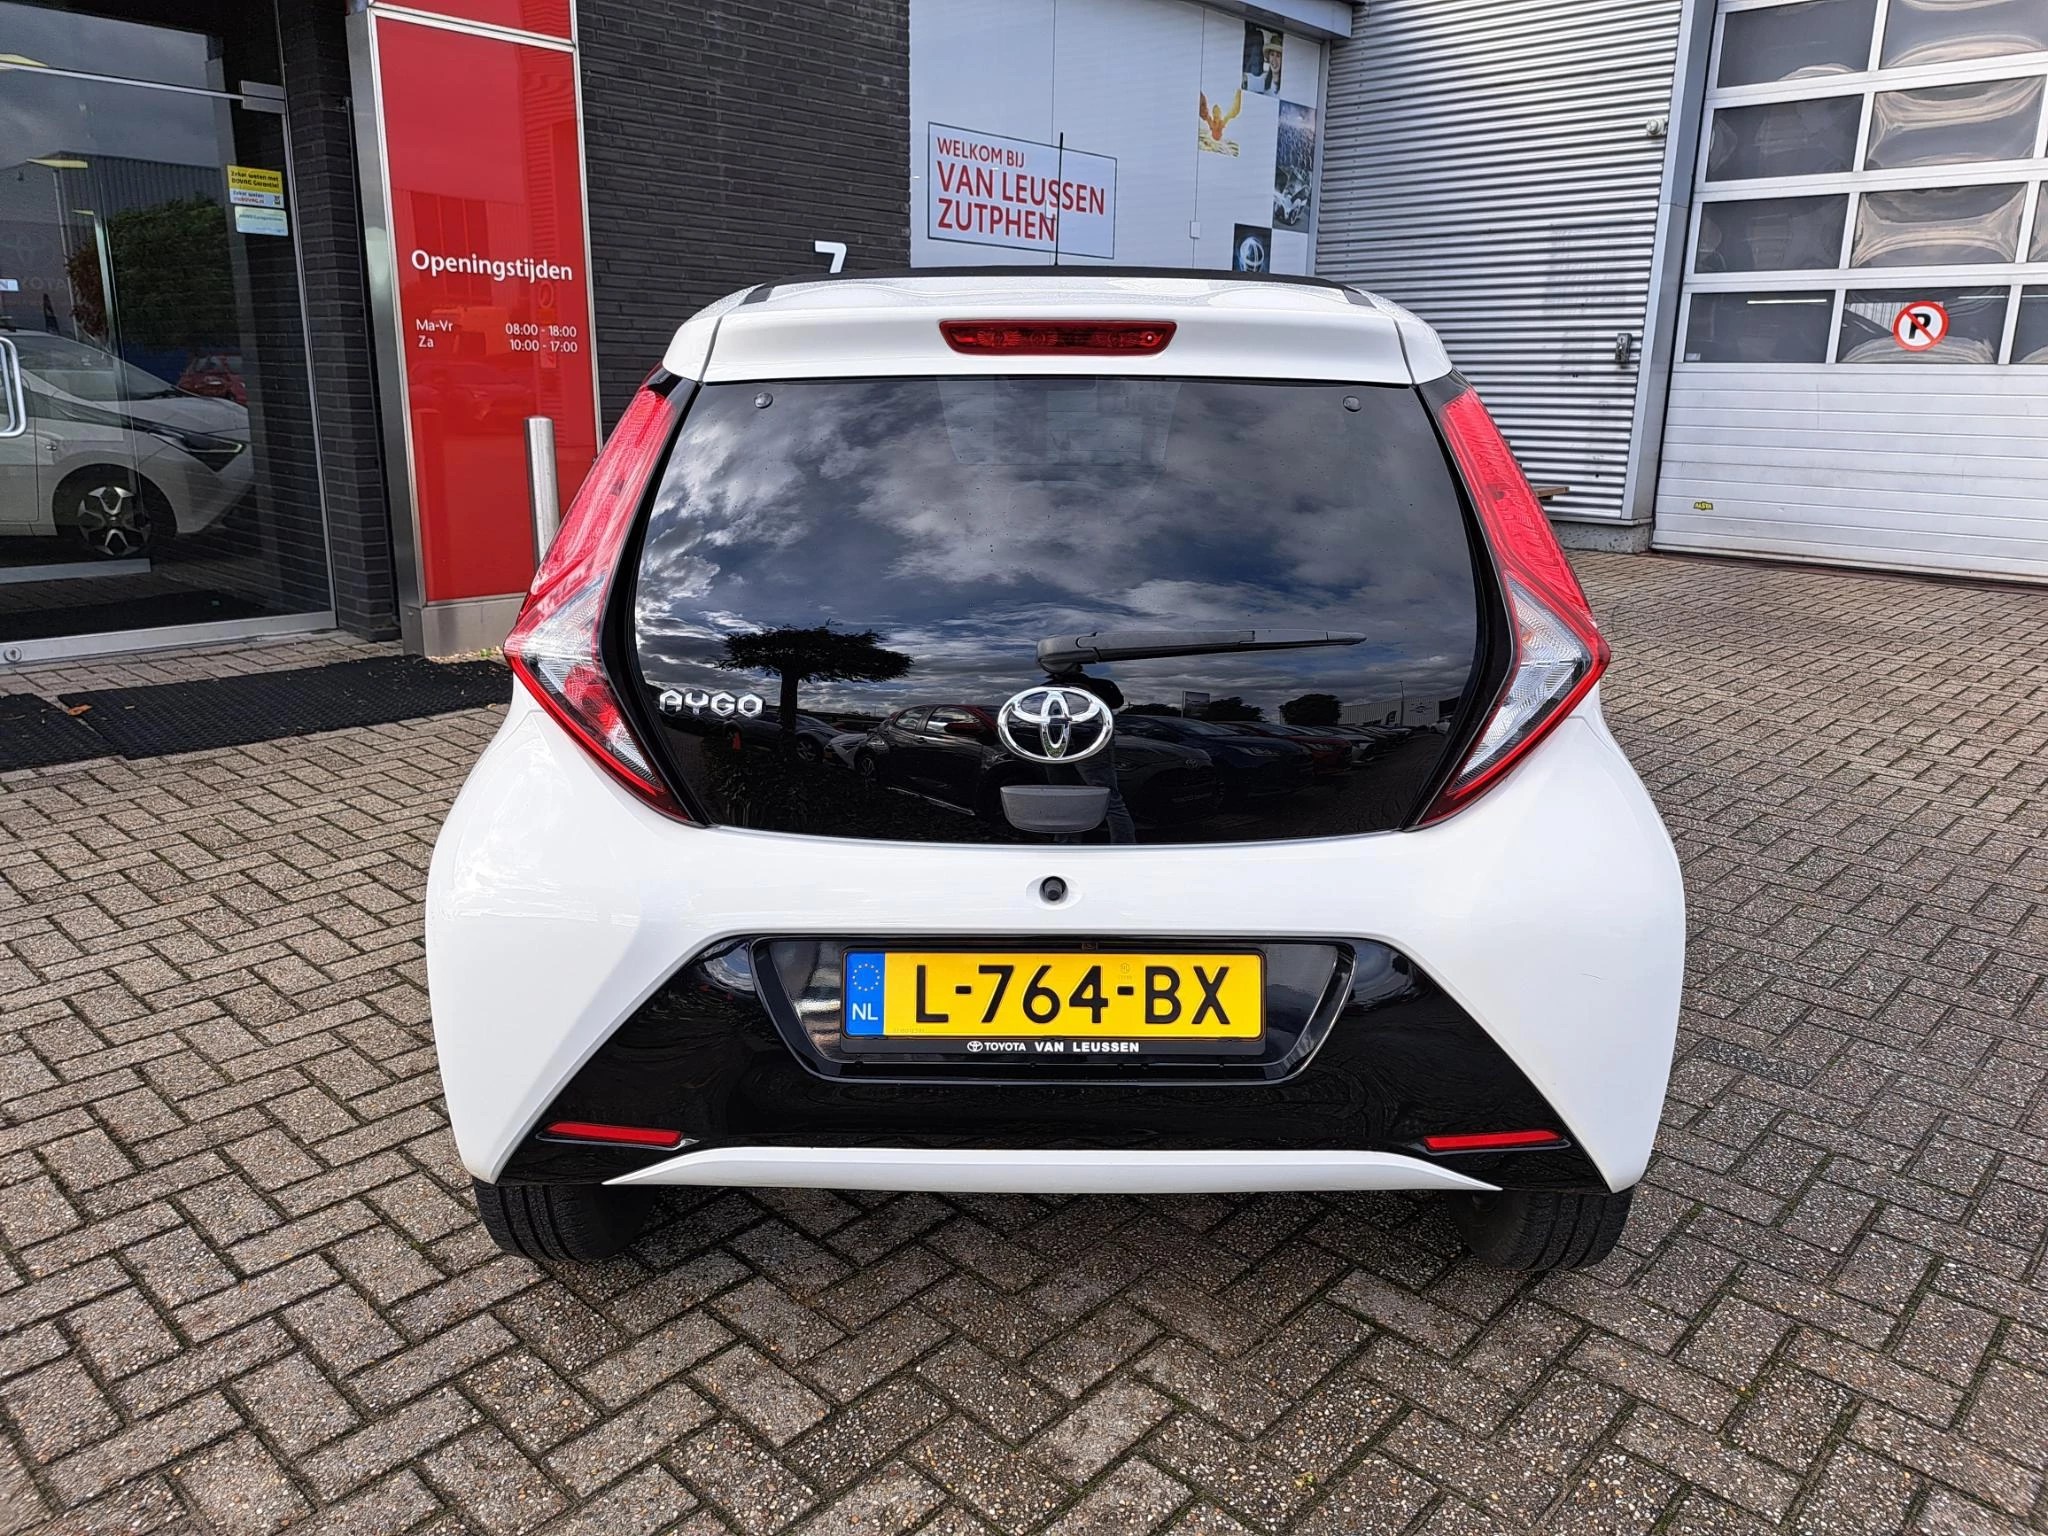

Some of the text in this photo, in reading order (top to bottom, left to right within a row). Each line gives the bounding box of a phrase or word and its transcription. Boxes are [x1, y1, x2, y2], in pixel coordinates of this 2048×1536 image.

[937, 136, 1025, 169] WELKOM BIJ
[936, 160, 1106, 216] VAN LEUSSEN
[937, 197, 1057, 242] ZUTPHEN
[411, 249, 573, 284] Openingstijden
[814, 240, 847, 274] 7
[415, 318, 454, 332] Ma-Vr
[505, 322, 539, 336] 08:00
[548, 325, 577, 338] 18:00
[418, 335, 435, 348] Za
[509, 339, 540, 352] 10:00
[550, 340, 578, 353] 17:00
[659, 688, 764, 718] AYGO
[915, 964, 1231, 1024] L-764-BX
[851, 1002, 879, 1021] NL
[983, 1041, 1140, 1053] TOYOTA VAN LEUSSEN
